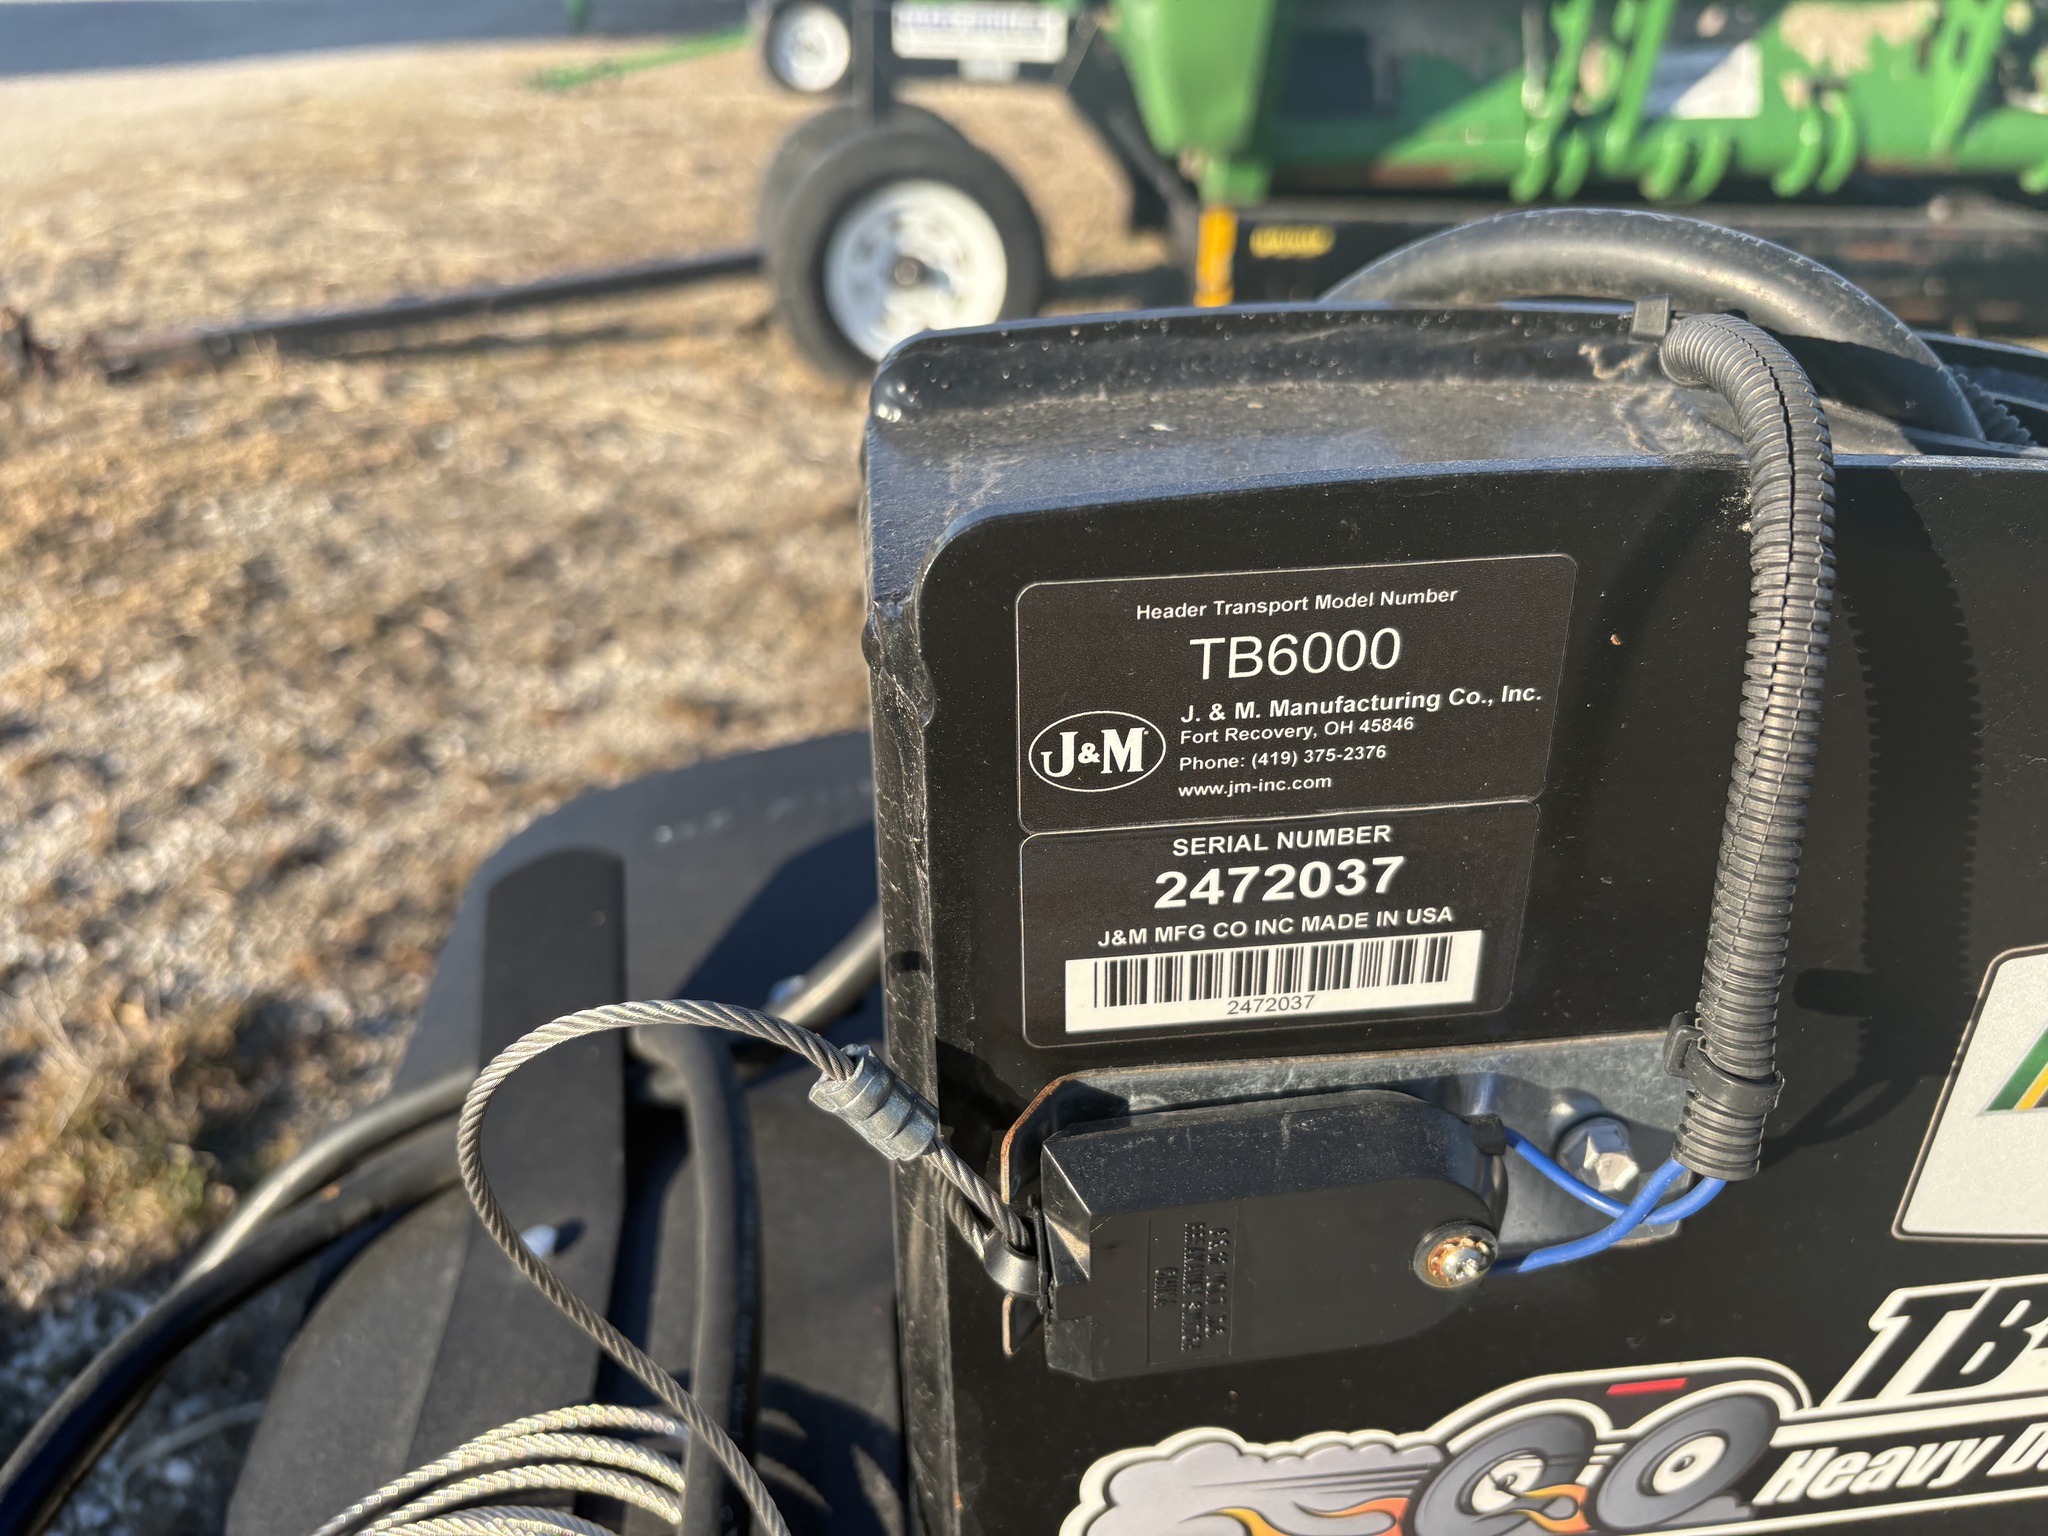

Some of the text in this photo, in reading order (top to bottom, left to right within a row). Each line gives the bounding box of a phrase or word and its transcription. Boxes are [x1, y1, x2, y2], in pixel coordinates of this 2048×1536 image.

[1136, 589, 1459, 621] Header Transport Model Number
[1189, 628, 1401, 681] TB6000
[1180, 686, 1542, 724] J. & M. Manufacturing Co., Inc.
[1180, 717, 1415, 745] Fort Recovery, OH 45846
[1040, 727, 1144, 778] J&M
[1179, 745, 1387, 772] Phone: (419) 375-2376
[1177, 777, 1332, 798] www.jm-inc.com
[1172, 825, 1392, 857] SERIAL NUMBER
[1153, 855, 1405, 909] 2472037
[1097, 907, 1454, 948] J&M MFG CO INC MADE IN USA
[1226, 994, 1315, 1015] 2472037
[1832, 1282, 2048, 1404] TB
[1752, 1421, 2048, 1506] Heavy D
